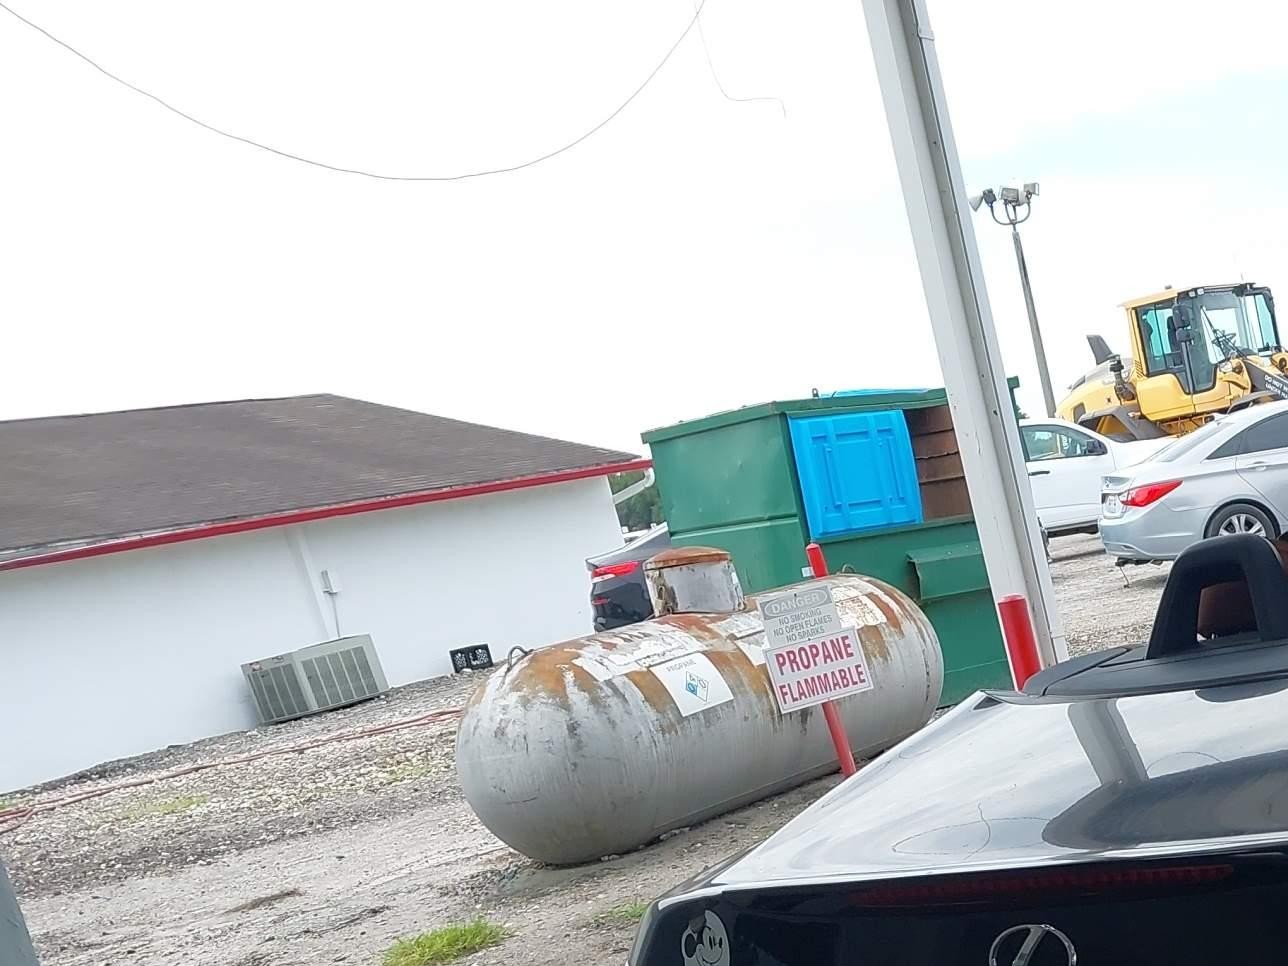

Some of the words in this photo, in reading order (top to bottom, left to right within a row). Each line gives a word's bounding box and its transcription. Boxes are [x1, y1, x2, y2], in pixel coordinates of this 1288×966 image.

[771, 593, 820, 614] DANGER
[773, 627, 784, 636] NO
[784, 621, 805, 634] OPEN
[805, 614, 833, 630] FLAMES
[778, 615, 790, 625] NO
[790, 608, 822, 624] SMOKING
[786, 634, 797, 643] NO
[797, 626, 825, 641] SPARKS
[774, 635, 855, 676] PROPANE
[778, 664, 867, 705] FLAMMABLE
